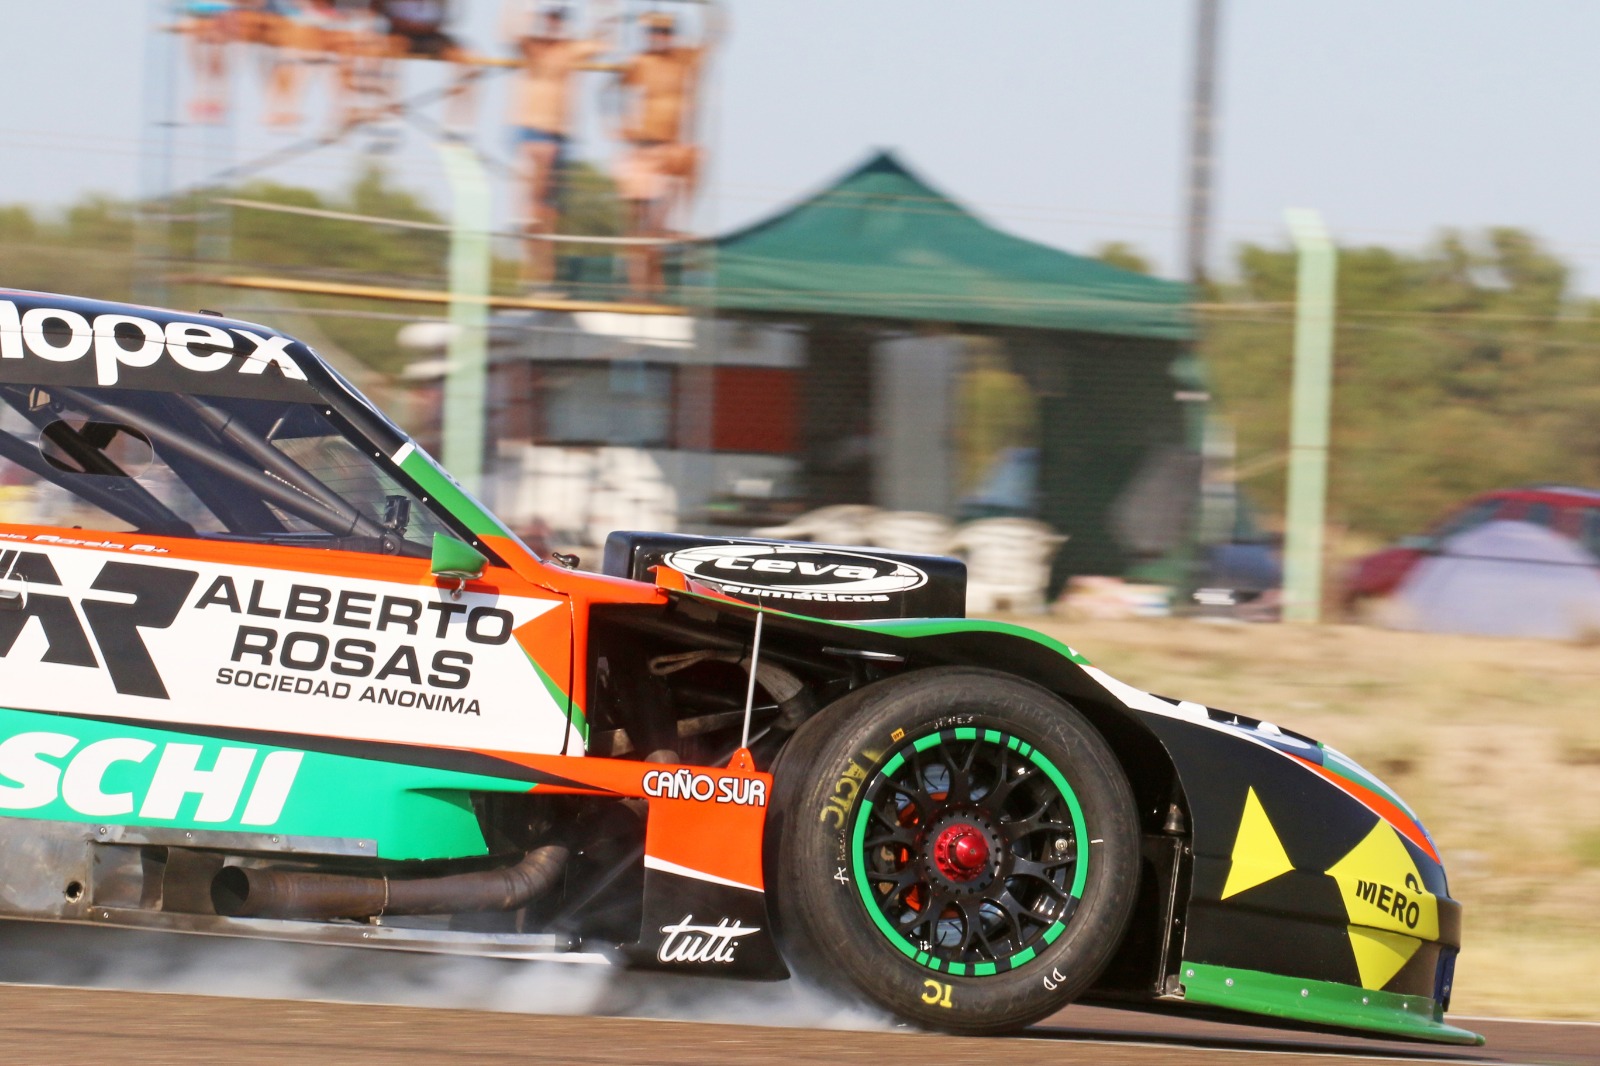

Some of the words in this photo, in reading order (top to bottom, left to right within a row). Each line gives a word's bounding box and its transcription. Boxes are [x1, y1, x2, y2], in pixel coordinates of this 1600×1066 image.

[194, 575, 514, 646] ALBERTO
[230, 624, 474, 690] ROSAS
[216, 667, 352, 700] SOCIEDAD
[358, 686, 482, 716] ANONIMA
[642, 768, 715, 802] CAÑO
[716, 776, 766, 807] SUR
[1355, 879, 1420, 930] MERO
[657, 914, 761, 963] tutti
